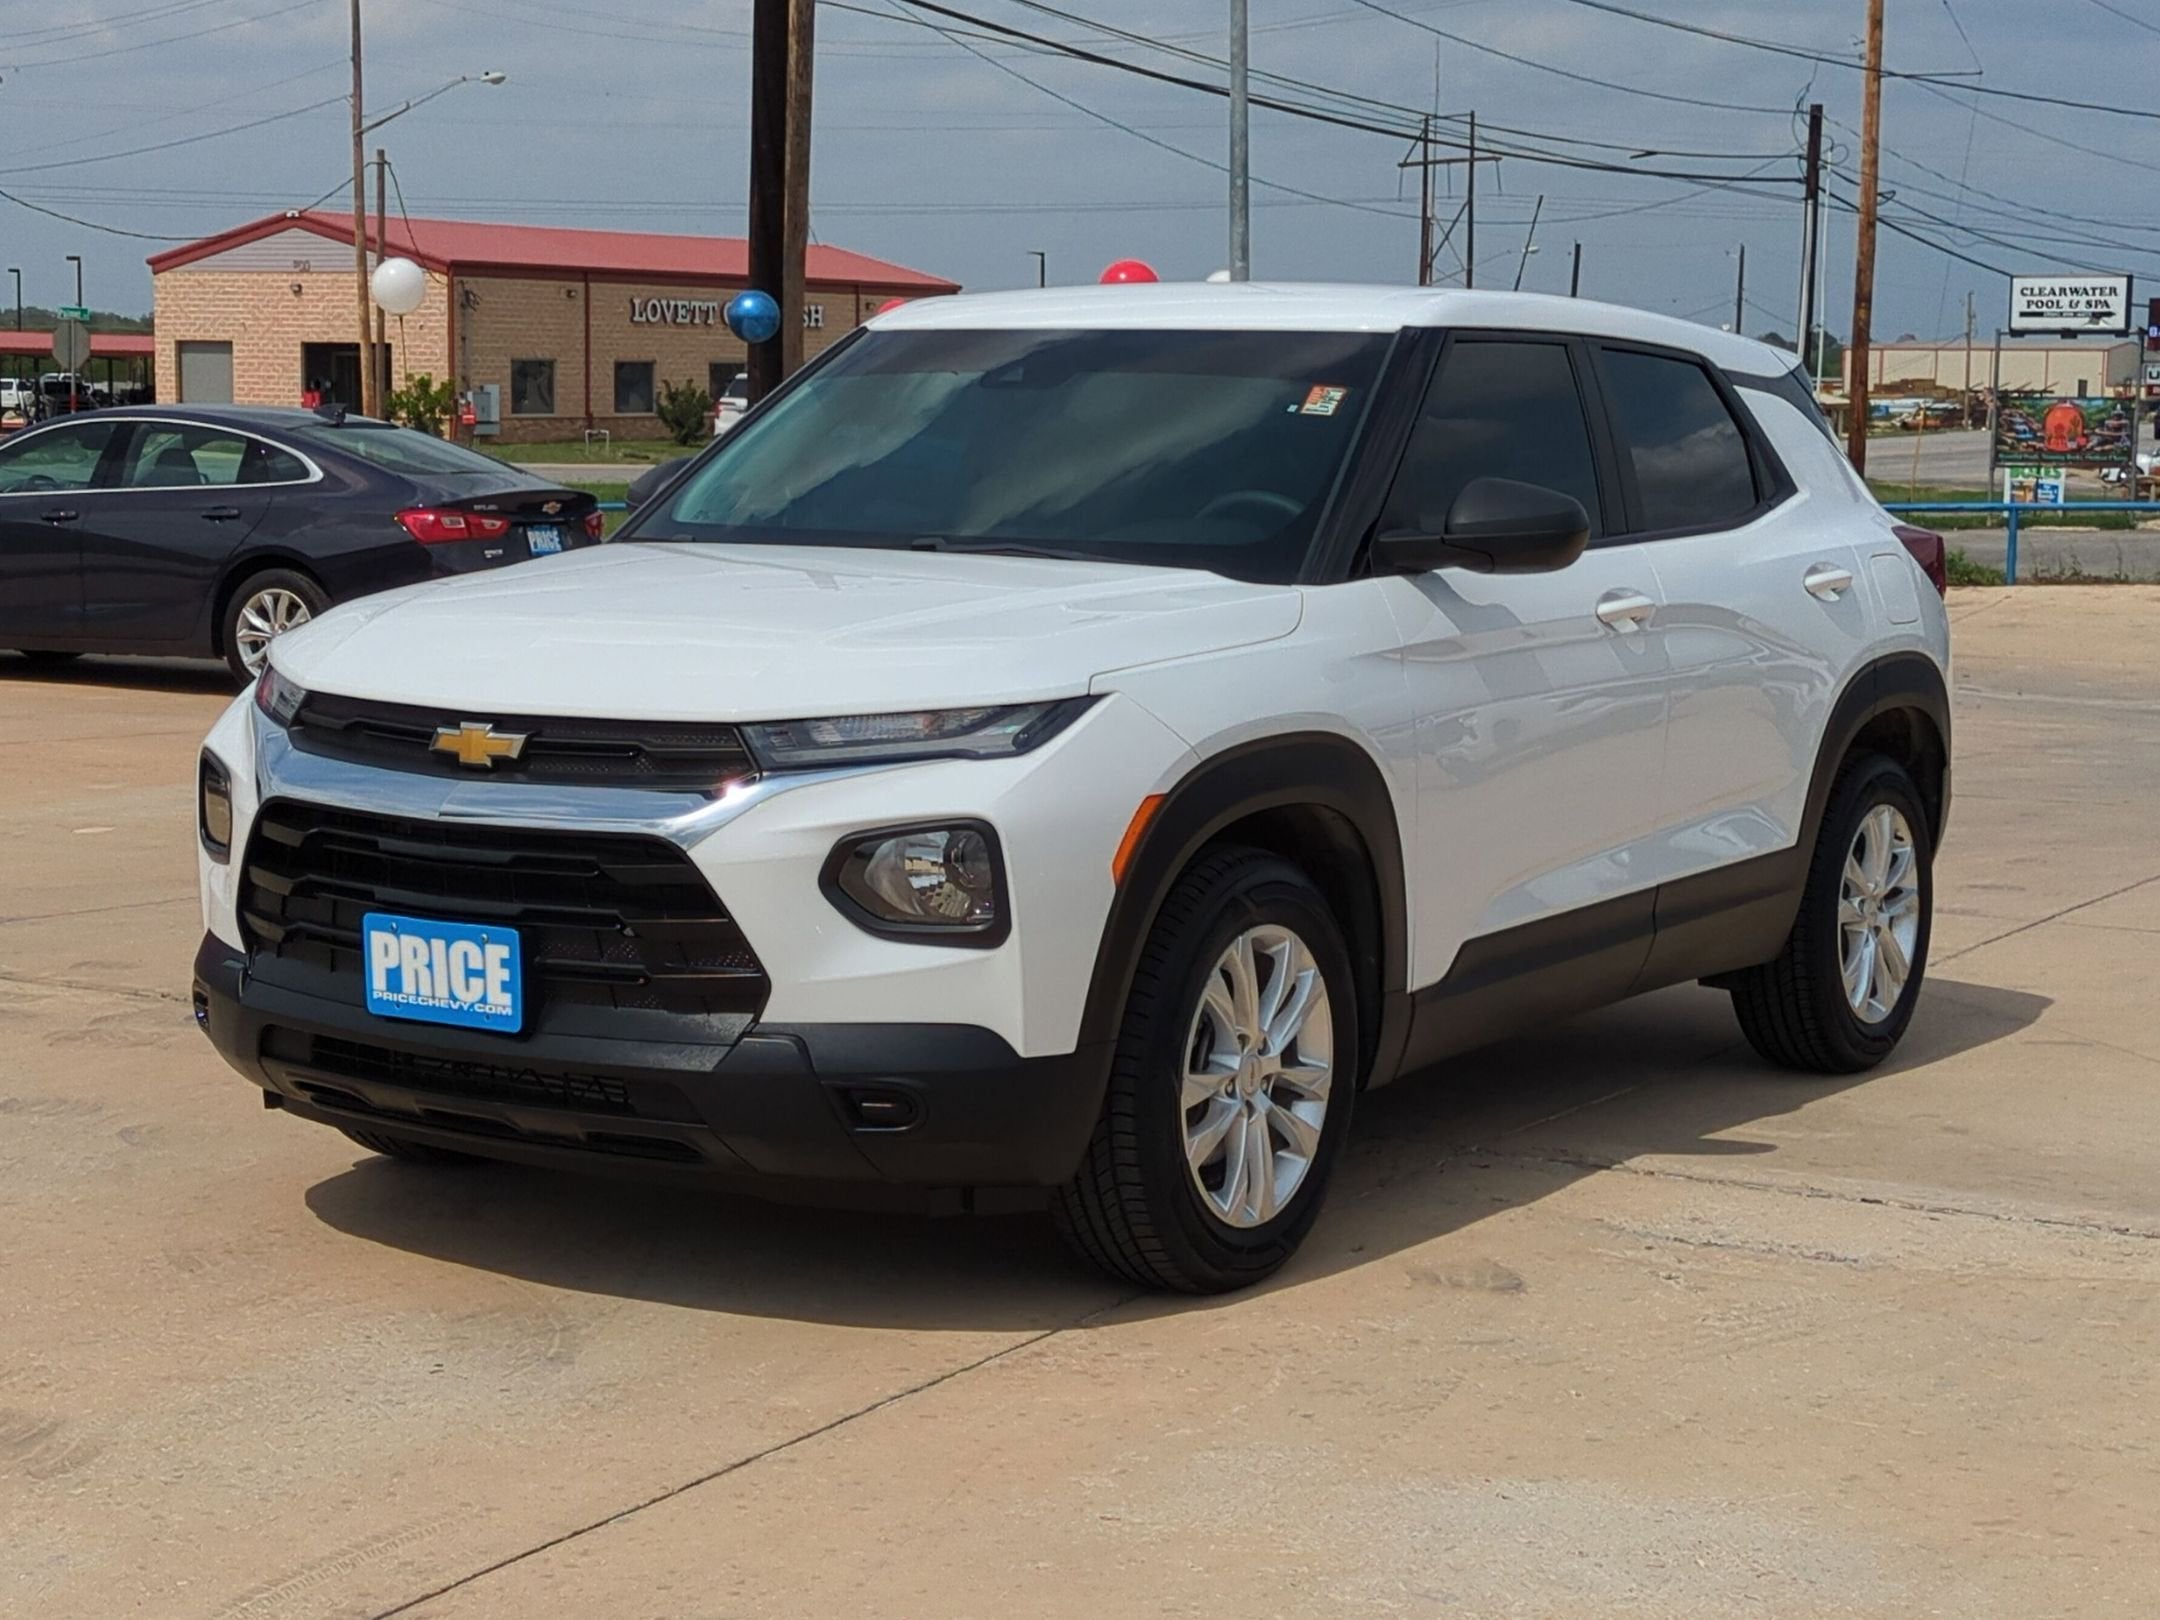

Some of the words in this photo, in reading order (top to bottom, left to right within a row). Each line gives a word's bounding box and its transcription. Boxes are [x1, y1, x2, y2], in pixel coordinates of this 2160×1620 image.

[2020, 286, 2119, 297] CLEARWATER
[633, 298, 718, 325] LOVETT
[2026, 300, 2064, 309] POOL
[2069, 300, 2080, 309] &
[2085, 300, 2111, 309] SPA
[527, 527, 562, 553] PRICE
[370, 930, 512, 1006] PRICE
[373, 991, 512, 1016] PRICECHEVY.COM
